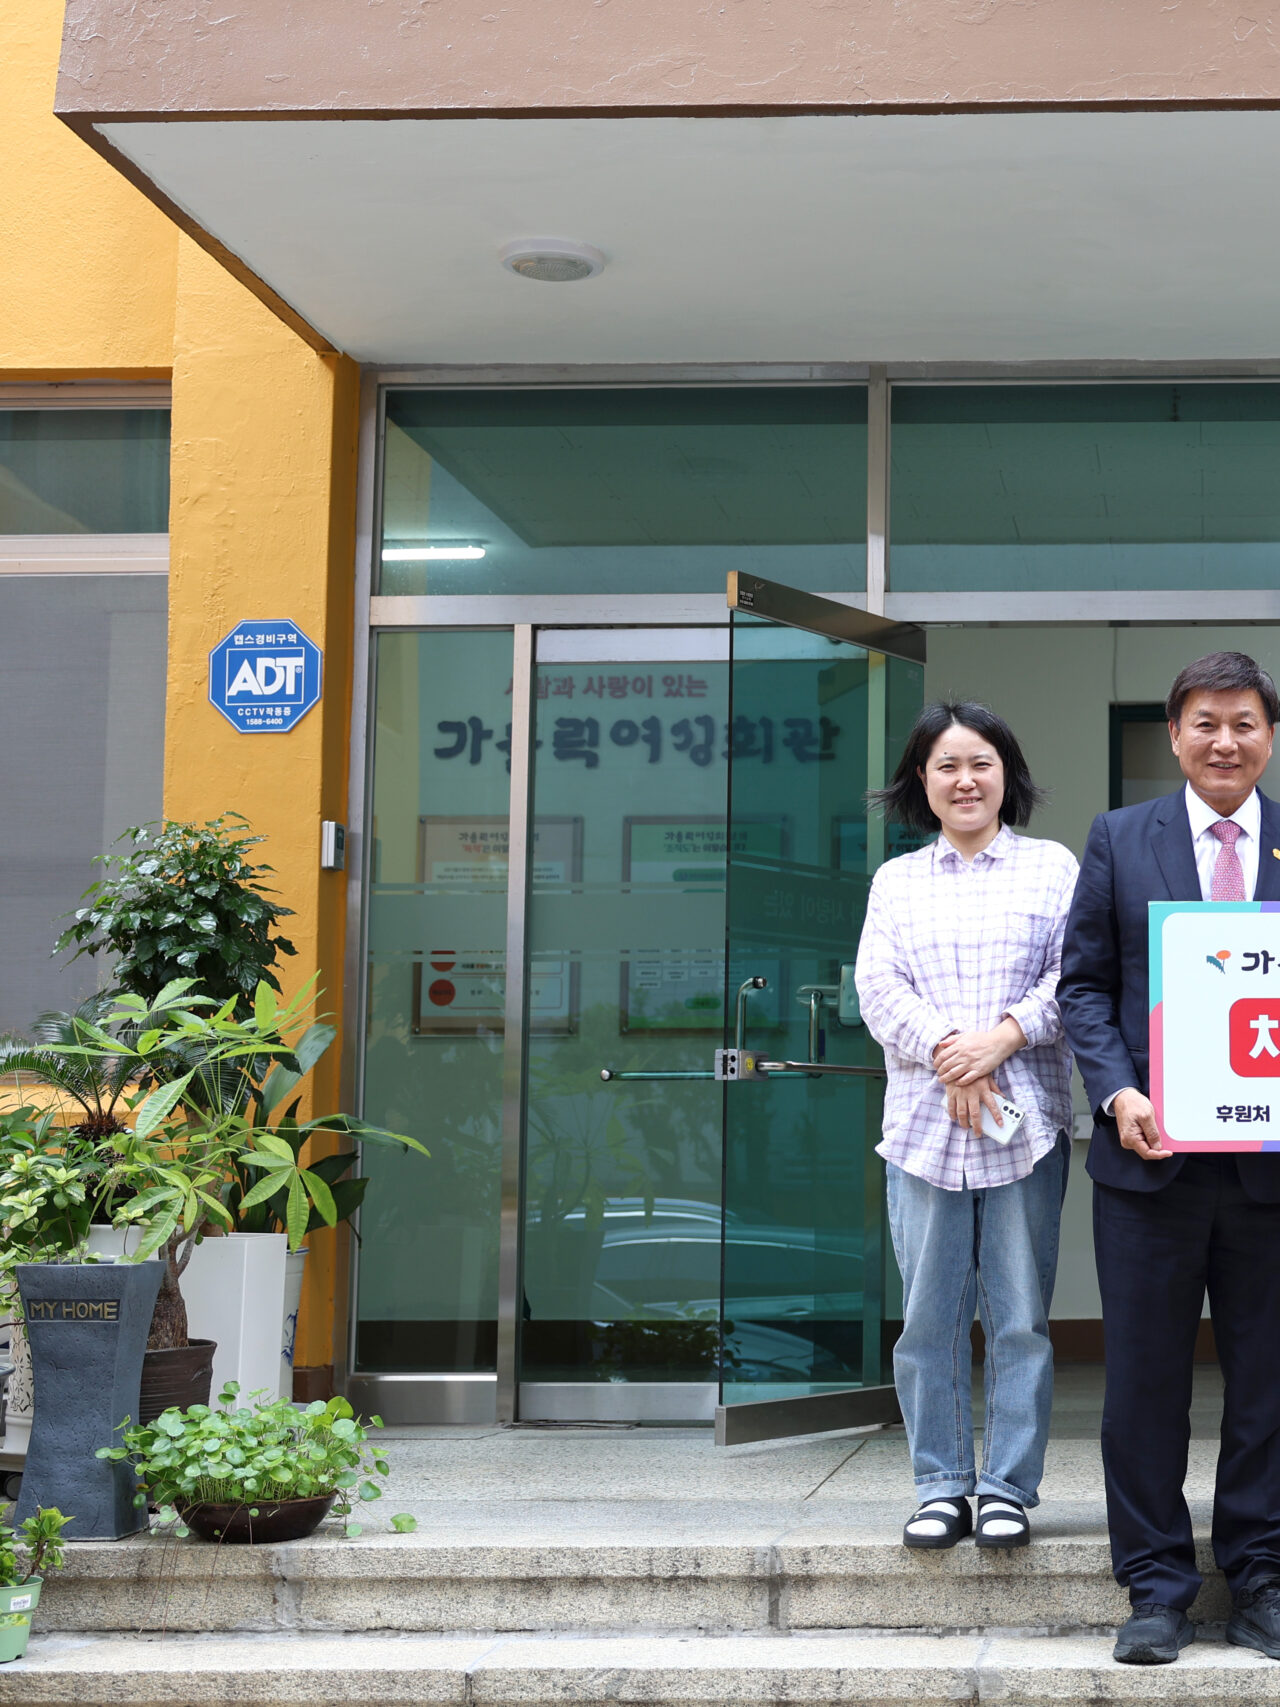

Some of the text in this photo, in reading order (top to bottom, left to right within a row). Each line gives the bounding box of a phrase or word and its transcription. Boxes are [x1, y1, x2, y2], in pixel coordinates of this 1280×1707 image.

[233, 633, 297, 645] 캡스경비구역
[227, 657, 304, 696] ADT
[582, 674, 653, 699] 사랑이
[661, 674, 708, 698] 있는
[237, 706, 292, 716] CCTV작동중
[1216, 1104, 1271, 1123] 후원처
[30, 1301, 118, 1319] MY HOME
